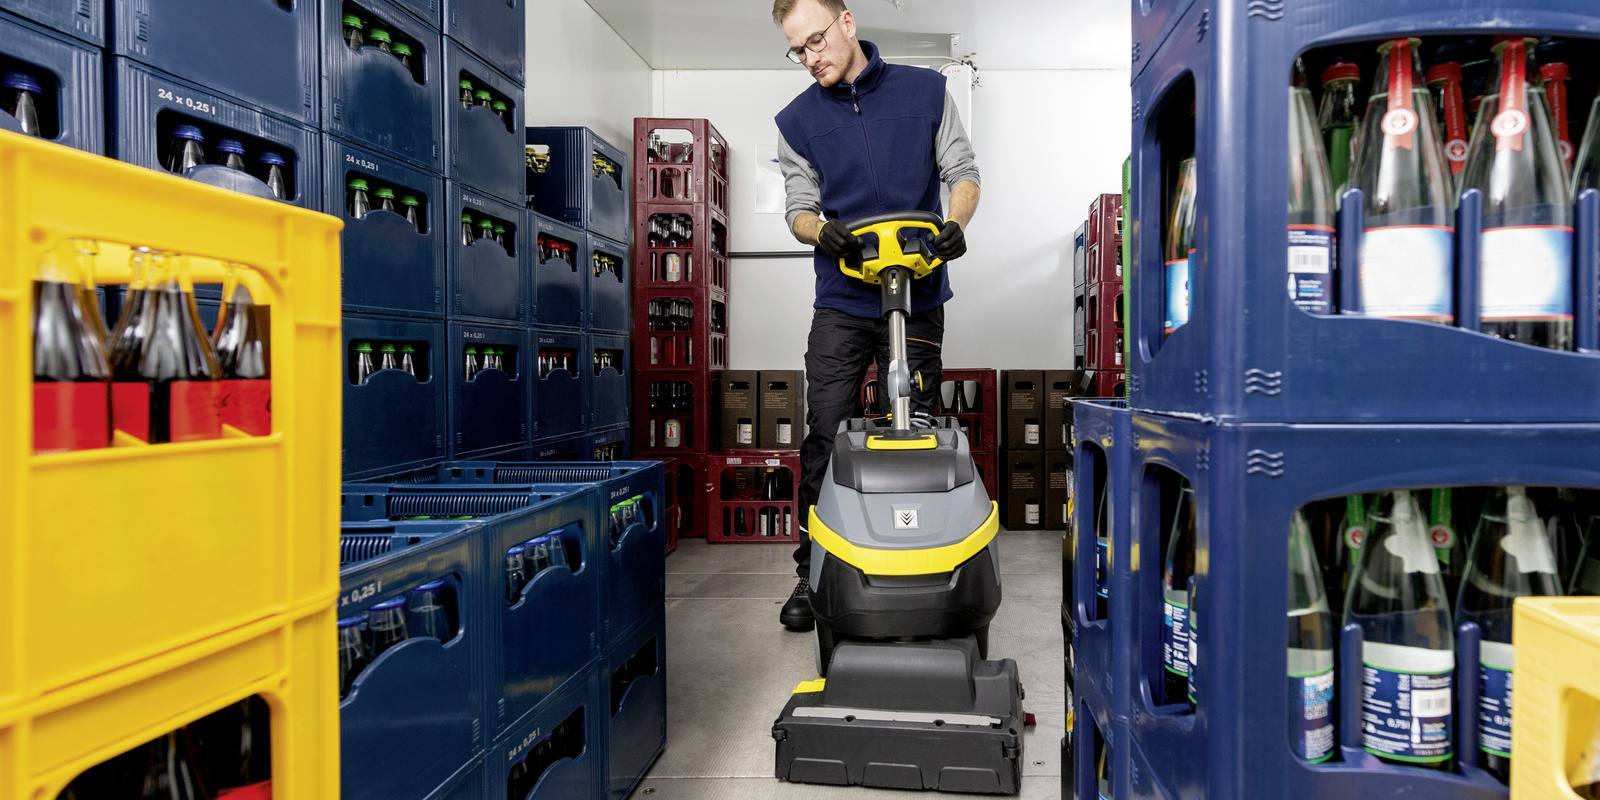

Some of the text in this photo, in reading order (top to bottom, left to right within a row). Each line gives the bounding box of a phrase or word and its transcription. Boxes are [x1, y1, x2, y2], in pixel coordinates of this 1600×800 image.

[158, 88, 173, 101] 24
[175, 96, 183, 104] x
[185, 97, 210, 113] 0,25
[346, 154, 355, 163] 24
[361, 160, 375, 170] 0,25
[351, 583, 376, 603] 0,25
